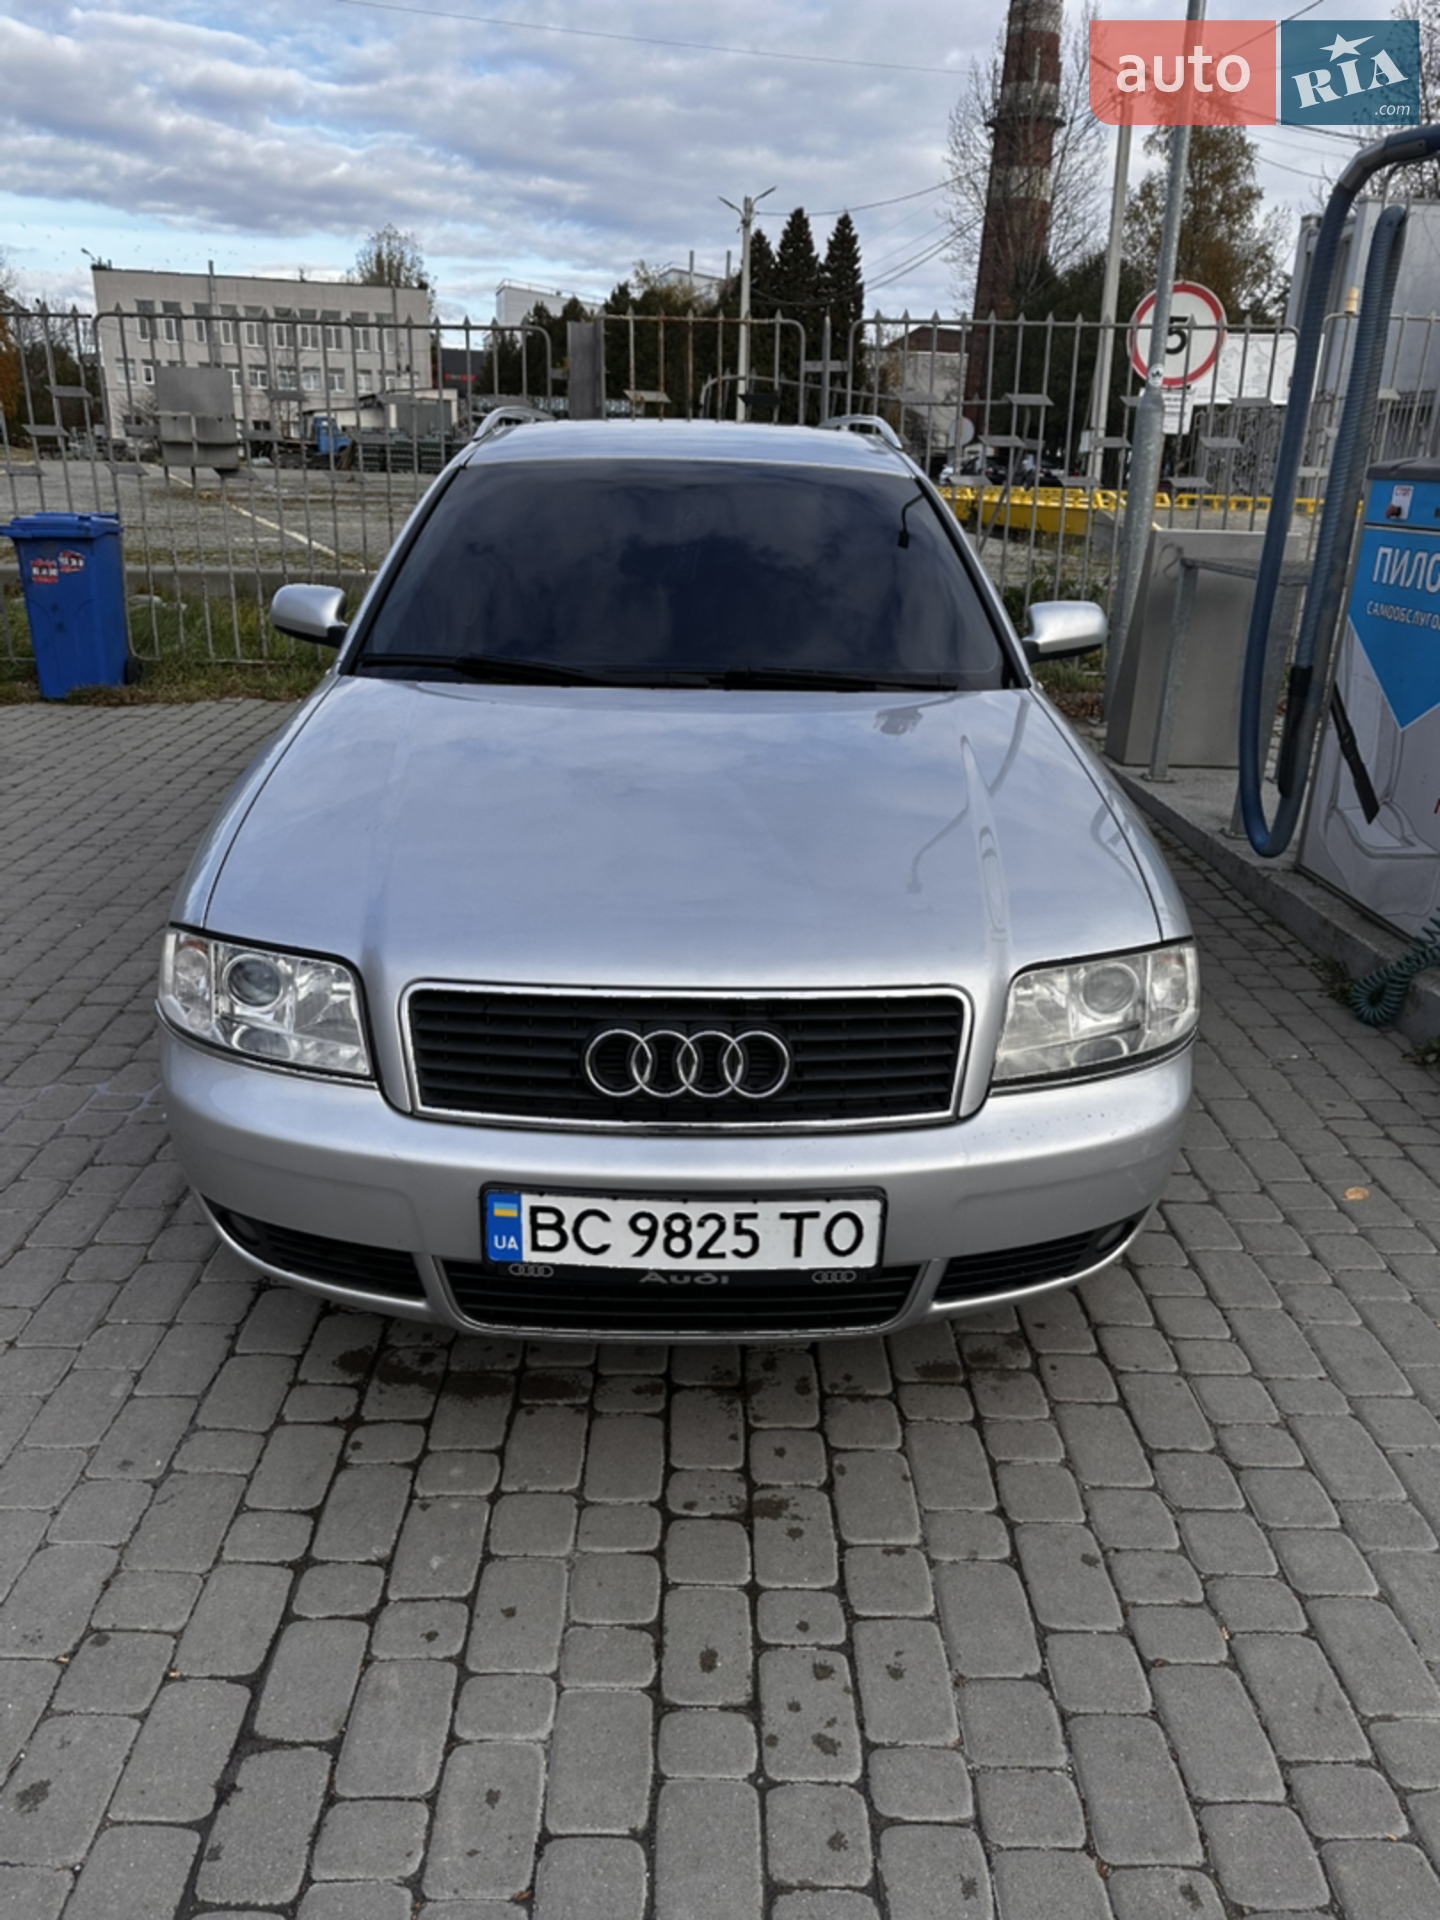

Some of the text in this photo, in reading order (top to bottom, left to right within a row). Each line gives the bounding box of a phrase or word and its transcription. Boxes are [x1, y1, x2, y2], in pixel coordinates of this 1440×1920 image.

[1165, 315, 1190, 355] 5
[1366, 600, 1440, 631] САМООБСЛУГО
[493, 1234, 519, 1251] UA
[529, 1205, 864, 1259] BC 9825 TO
[639, 1270, 729, 1284] Audi
